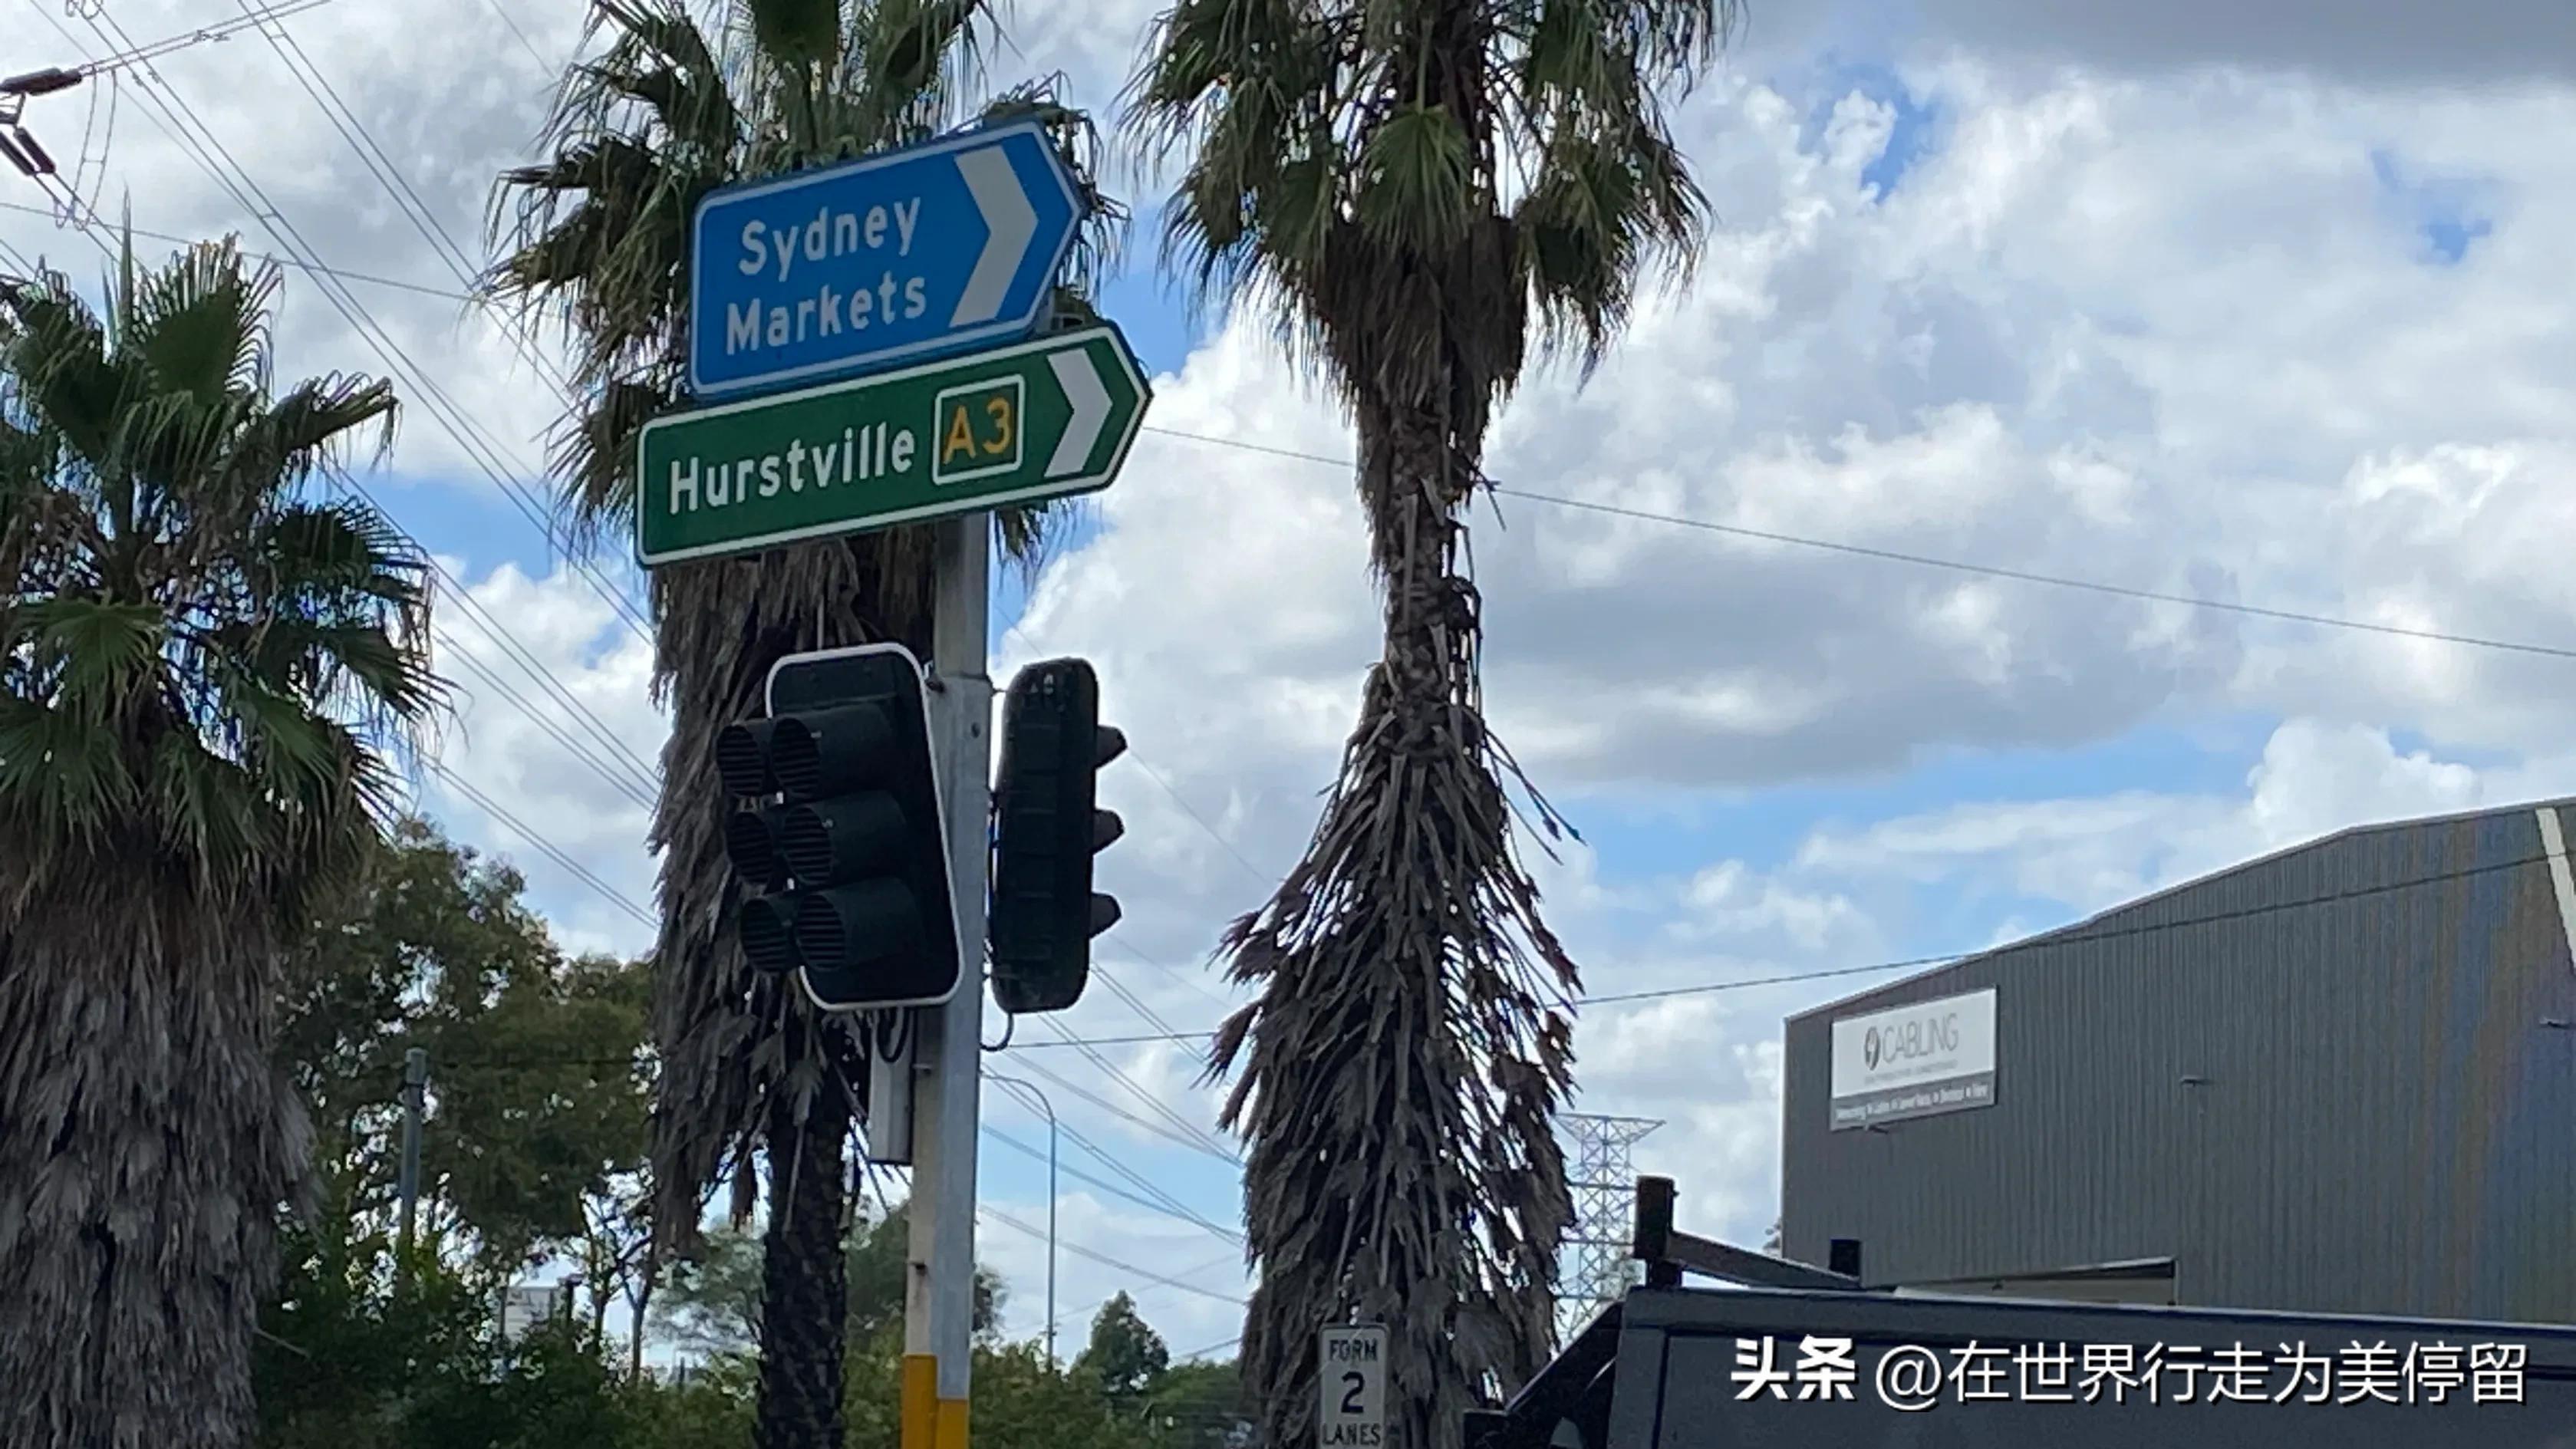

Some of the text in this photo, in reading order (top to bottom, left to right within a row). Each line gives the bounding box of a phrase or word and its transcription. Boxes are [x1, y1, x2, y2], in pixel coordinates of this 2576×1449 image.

[738, 196, 920, 282] Sydney
[726, 271, 927, 356] Markets
[670, 397, 1012, 515] Hurstville A3
[1883, 1013, 1958, 1062] CABLING
[1329, 1340, 1378, 1362] FORM
[1341, 1371, 1365, 1413] 2
[1323, 1423, 1380, 1444] LANES
